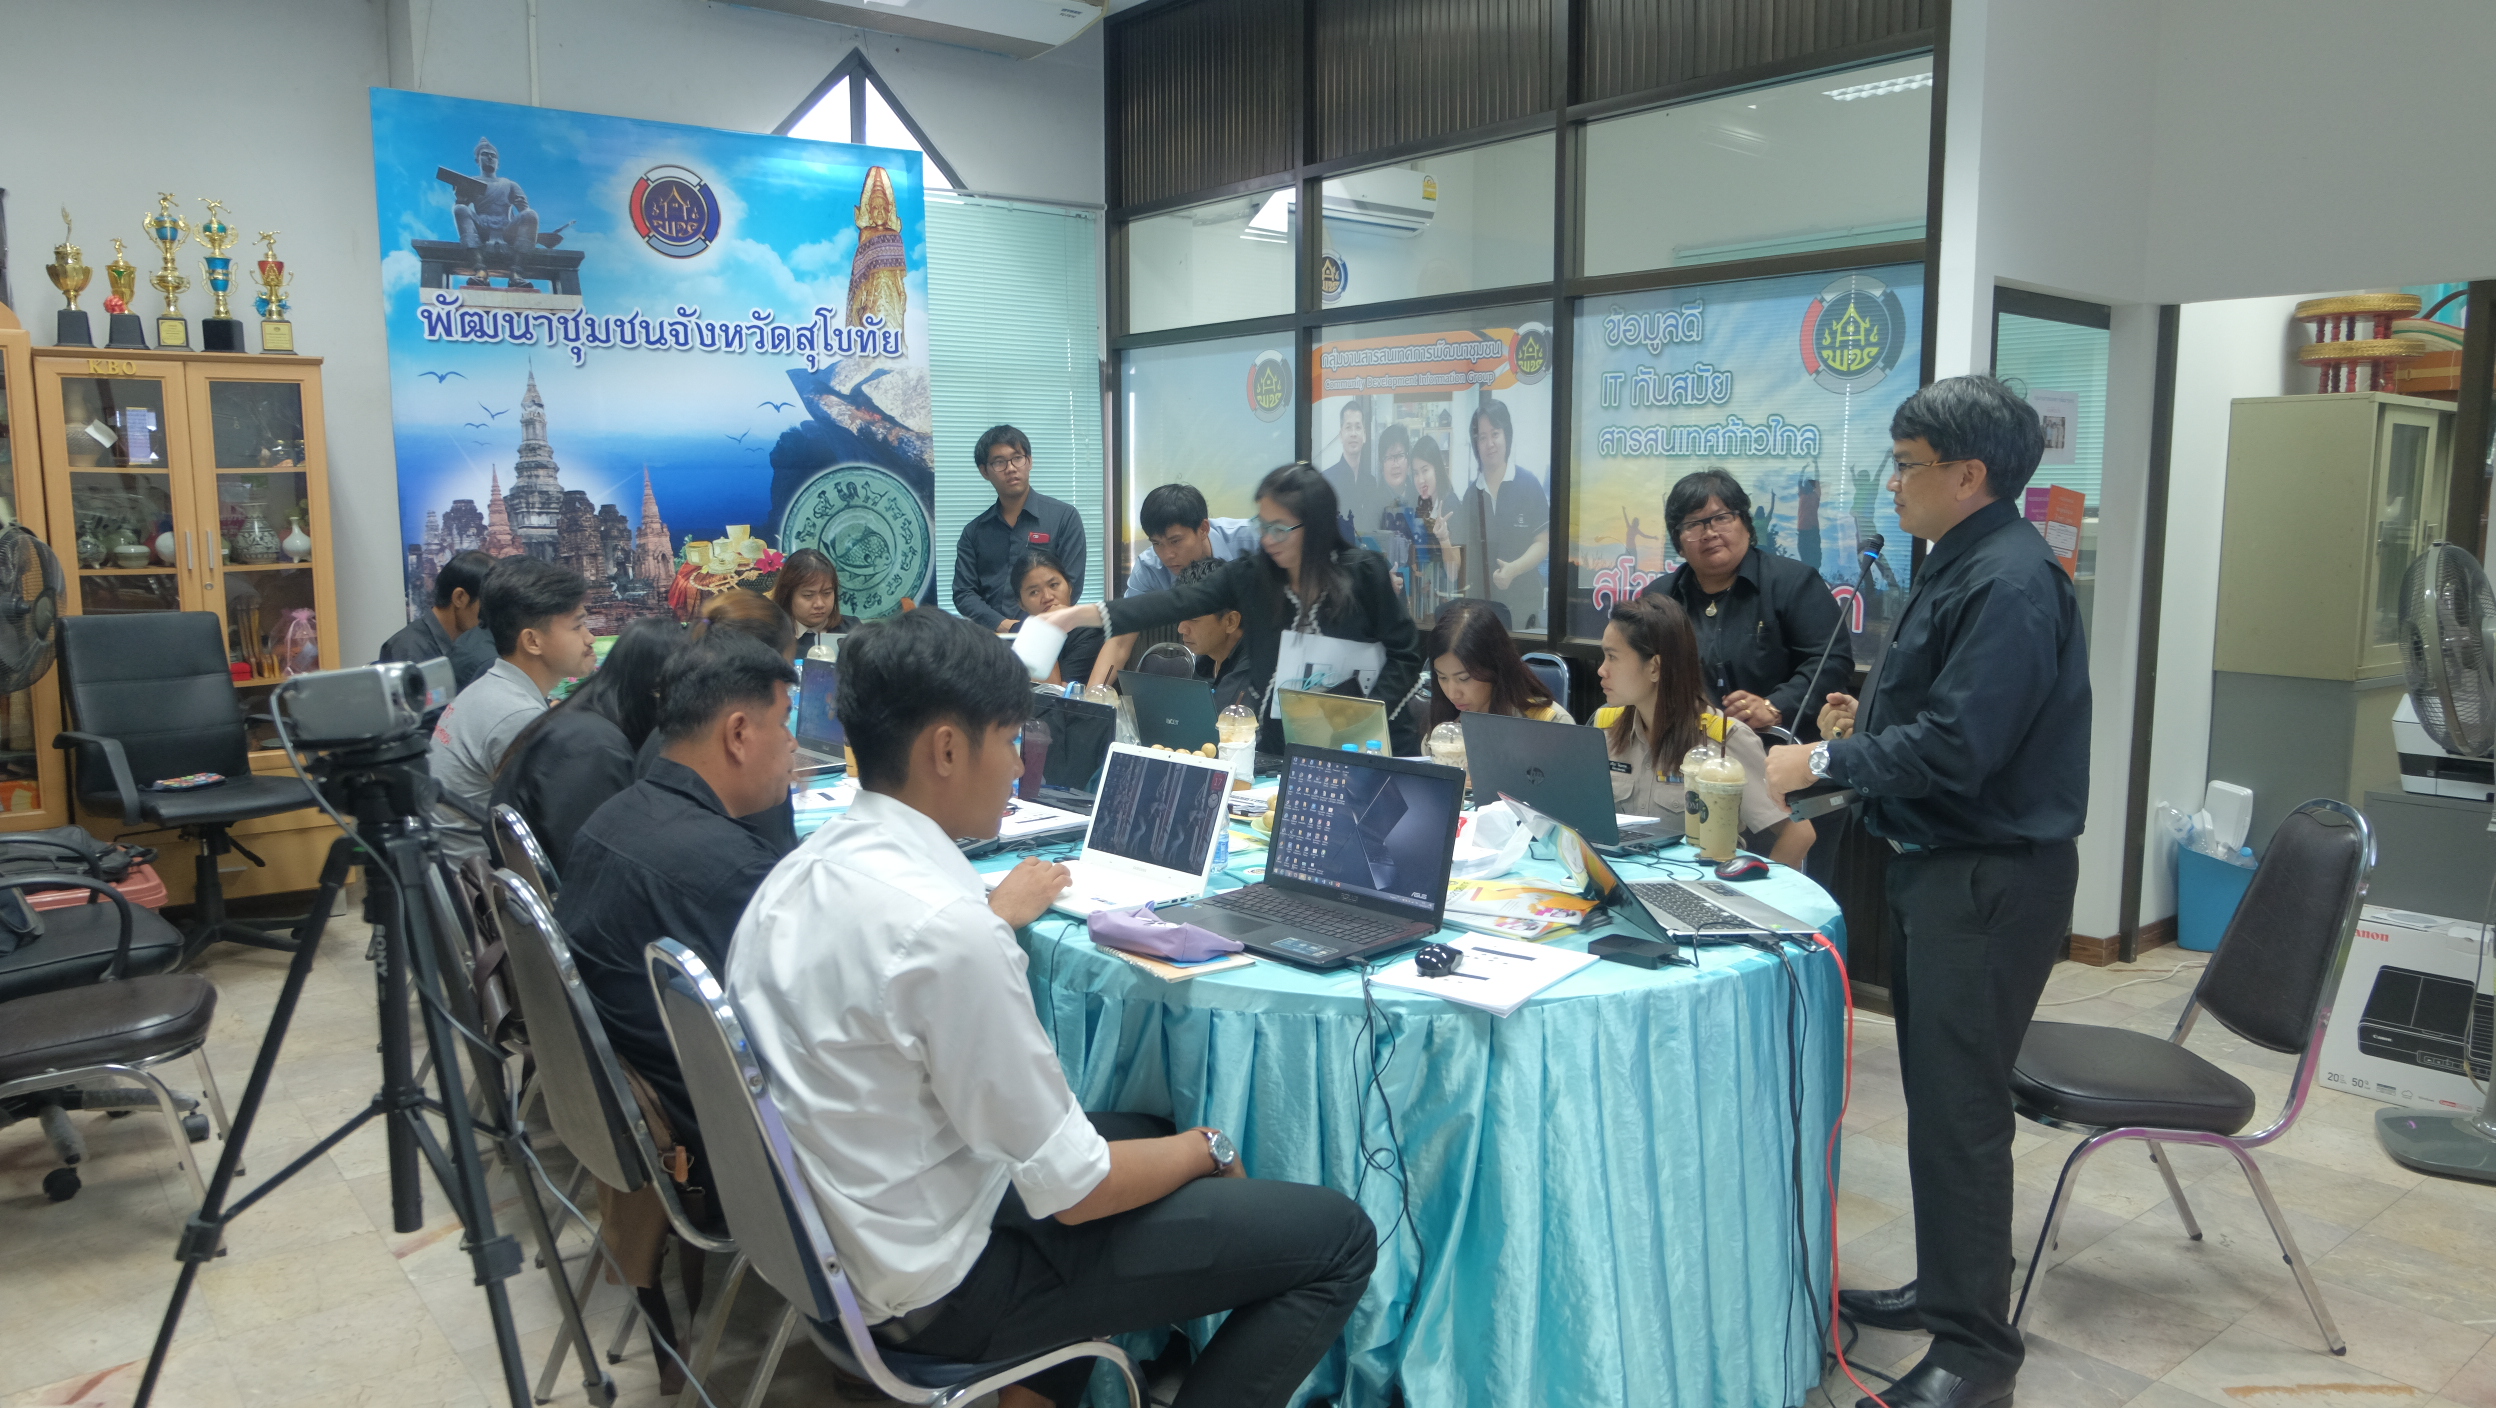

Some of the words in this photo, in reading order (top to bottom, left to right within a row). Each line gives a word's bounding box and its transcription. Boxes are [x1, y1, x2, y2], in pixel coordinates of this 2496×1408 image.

[419, 292, 902, 371] พัฒนาชุมชนจังหวัดสุโขทัย
[88, 359, 137, 375] KBO
[1324, 378, 1366, 390] Community
[1366, 374, 1418, 389] Development
[1418, 373, 1466, 387] Information
[1466, 371, 1495, 385] Group
[1602, 372, 1625, 406] IT
[1631, 362, 1732, 405] ทันสมัย
[1411, 891, 1428, 900] ASUS
[2355, 929, 2389, 942] anon
[374, 924, 389, 978] SONY
[2327, 1071, 2340, 1083] 20
[2351, 1077, 2364, 1088] 50
